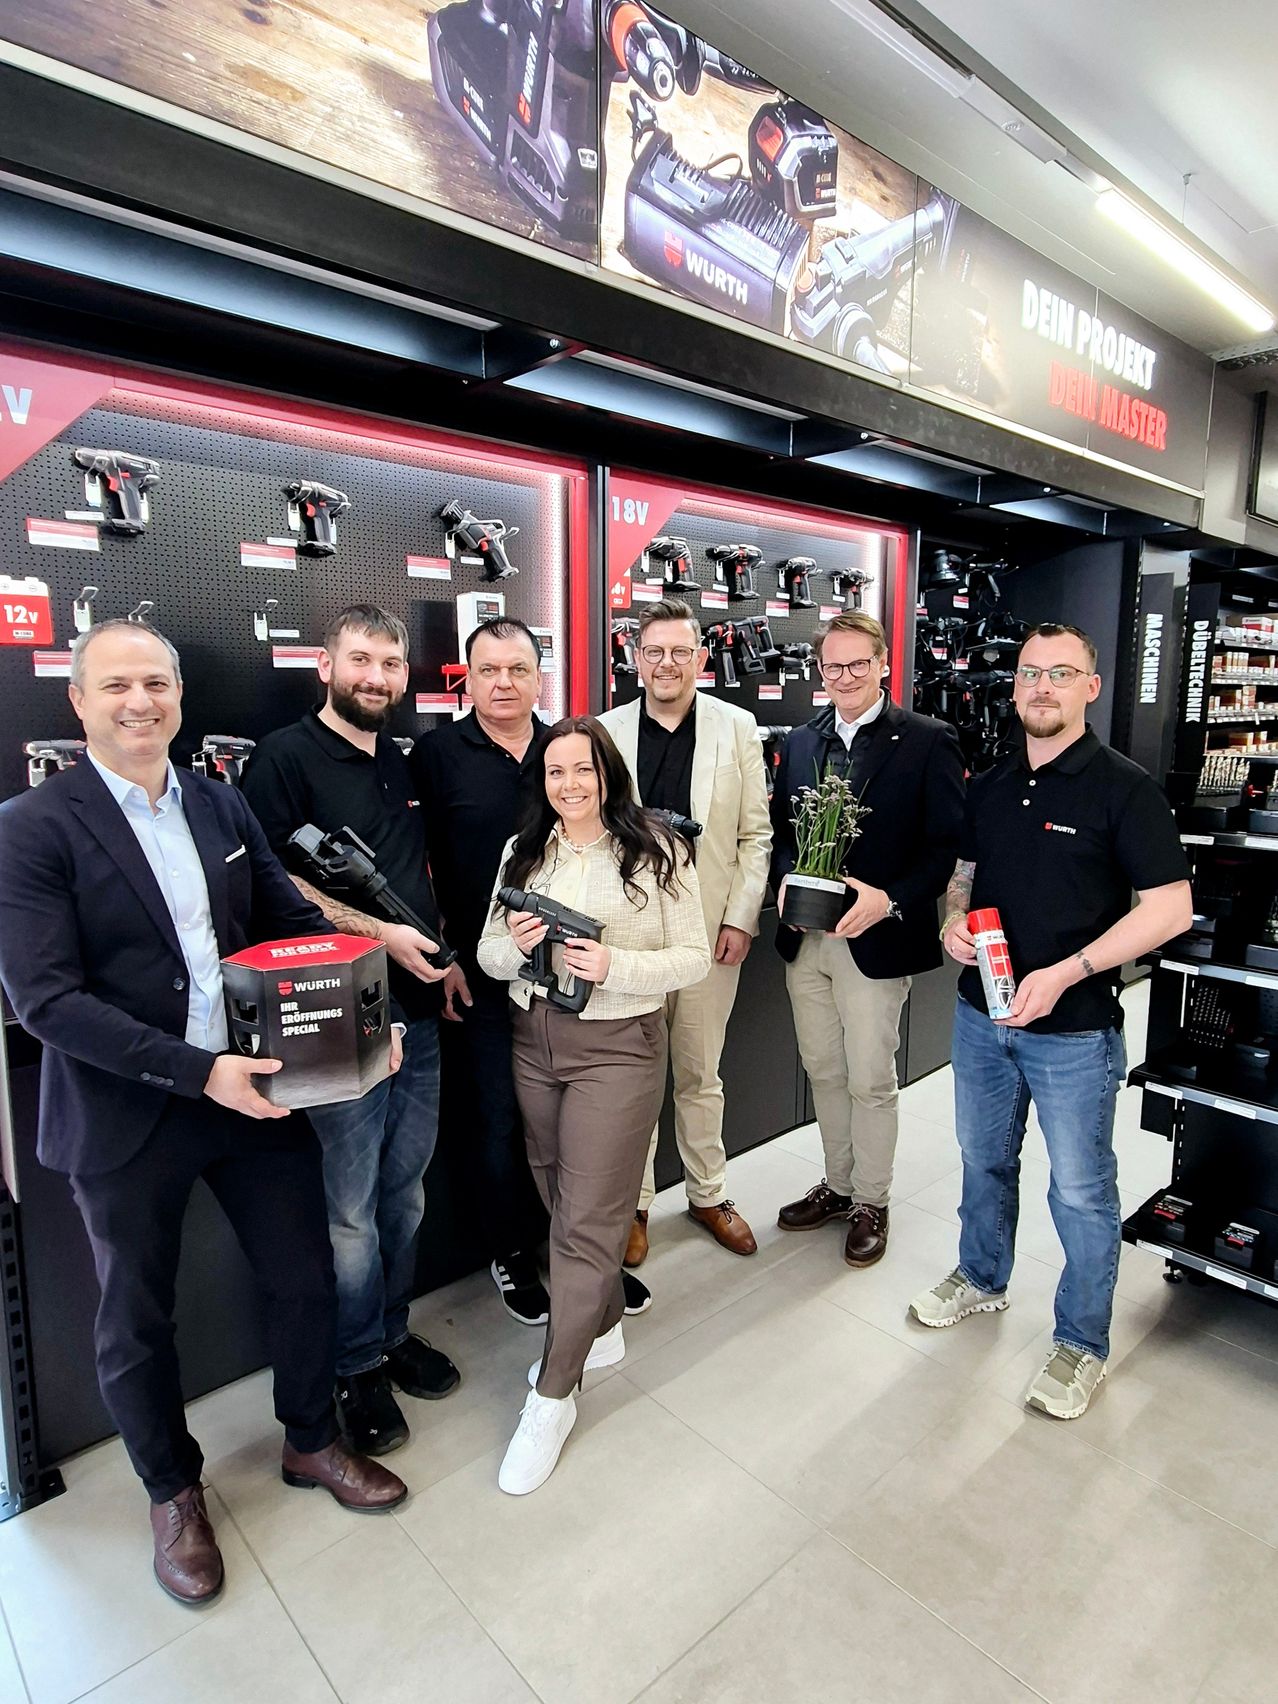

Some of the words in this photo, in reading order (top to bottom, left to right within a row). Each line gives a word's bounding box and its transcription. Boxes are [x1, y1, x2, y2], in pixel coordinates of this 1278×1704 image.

[1022, 278, 1074, 349] DEIN
[1076, 309, 1157, 391] PROJEKT
[0, 384, 33, 425] V
[1049, 360, 1097, 422] DEIN
[1099, 383, 1168, 451] MASTER
[612, 495, 649, 526] 18V
[1139, 613, 1164, 704] MASCHINEN
[1185, 620, 1212, 723] DÜBELTECHNIK
[280, 1002, 299, 1012] IHR
[281, 1008, 342, 1024] ERÖFFNUNGS
[281, 1024, 320, 1036] SPECIAL
